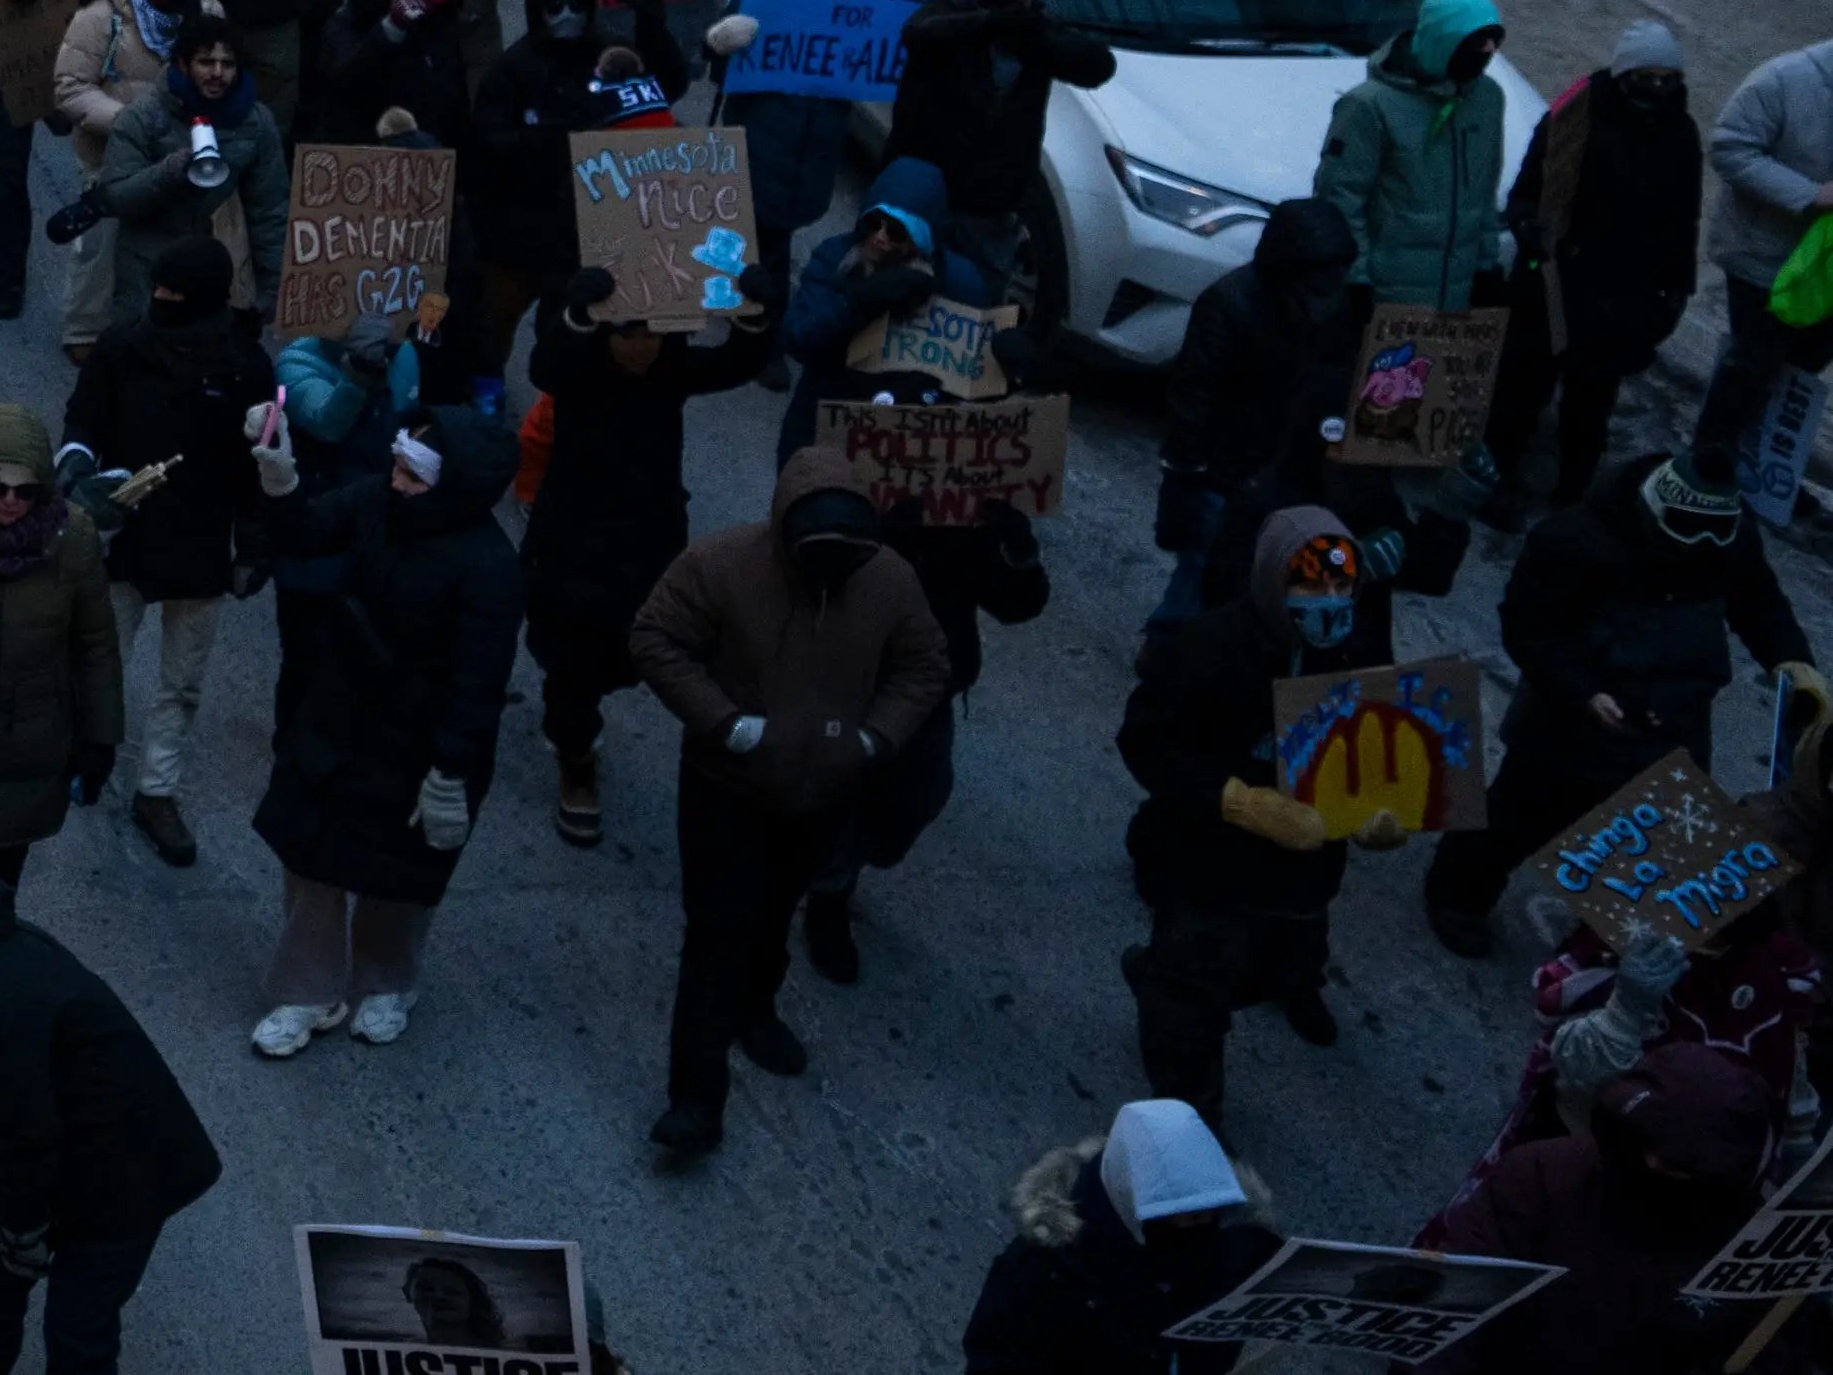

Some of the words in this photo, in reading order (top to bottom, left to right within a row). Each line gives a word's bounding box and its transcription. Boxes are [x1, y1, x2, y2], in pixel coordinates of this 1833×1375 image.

[831, 4, 876, 28] FOR
[733, 30, 833, 78] RENEE
[572, 131, 739, 203] Minnesota
[289, 215, 447, 268] DEMENTIA
[282, 271, 349, 330] HAS
[829, 407, 875, 427] This
[965, 409, 1031, 434] About
[1776, 378, 1815, 432] BEST
[845, 426, 1032, 467] POLITICS
[1600, 857, 1668, 902] La
[1653, 837, 1780, 931] Migra
[1703, 1261, 1815, 1295] RENEE
[1208, 1293, 1480, 1334] JUSTICE
